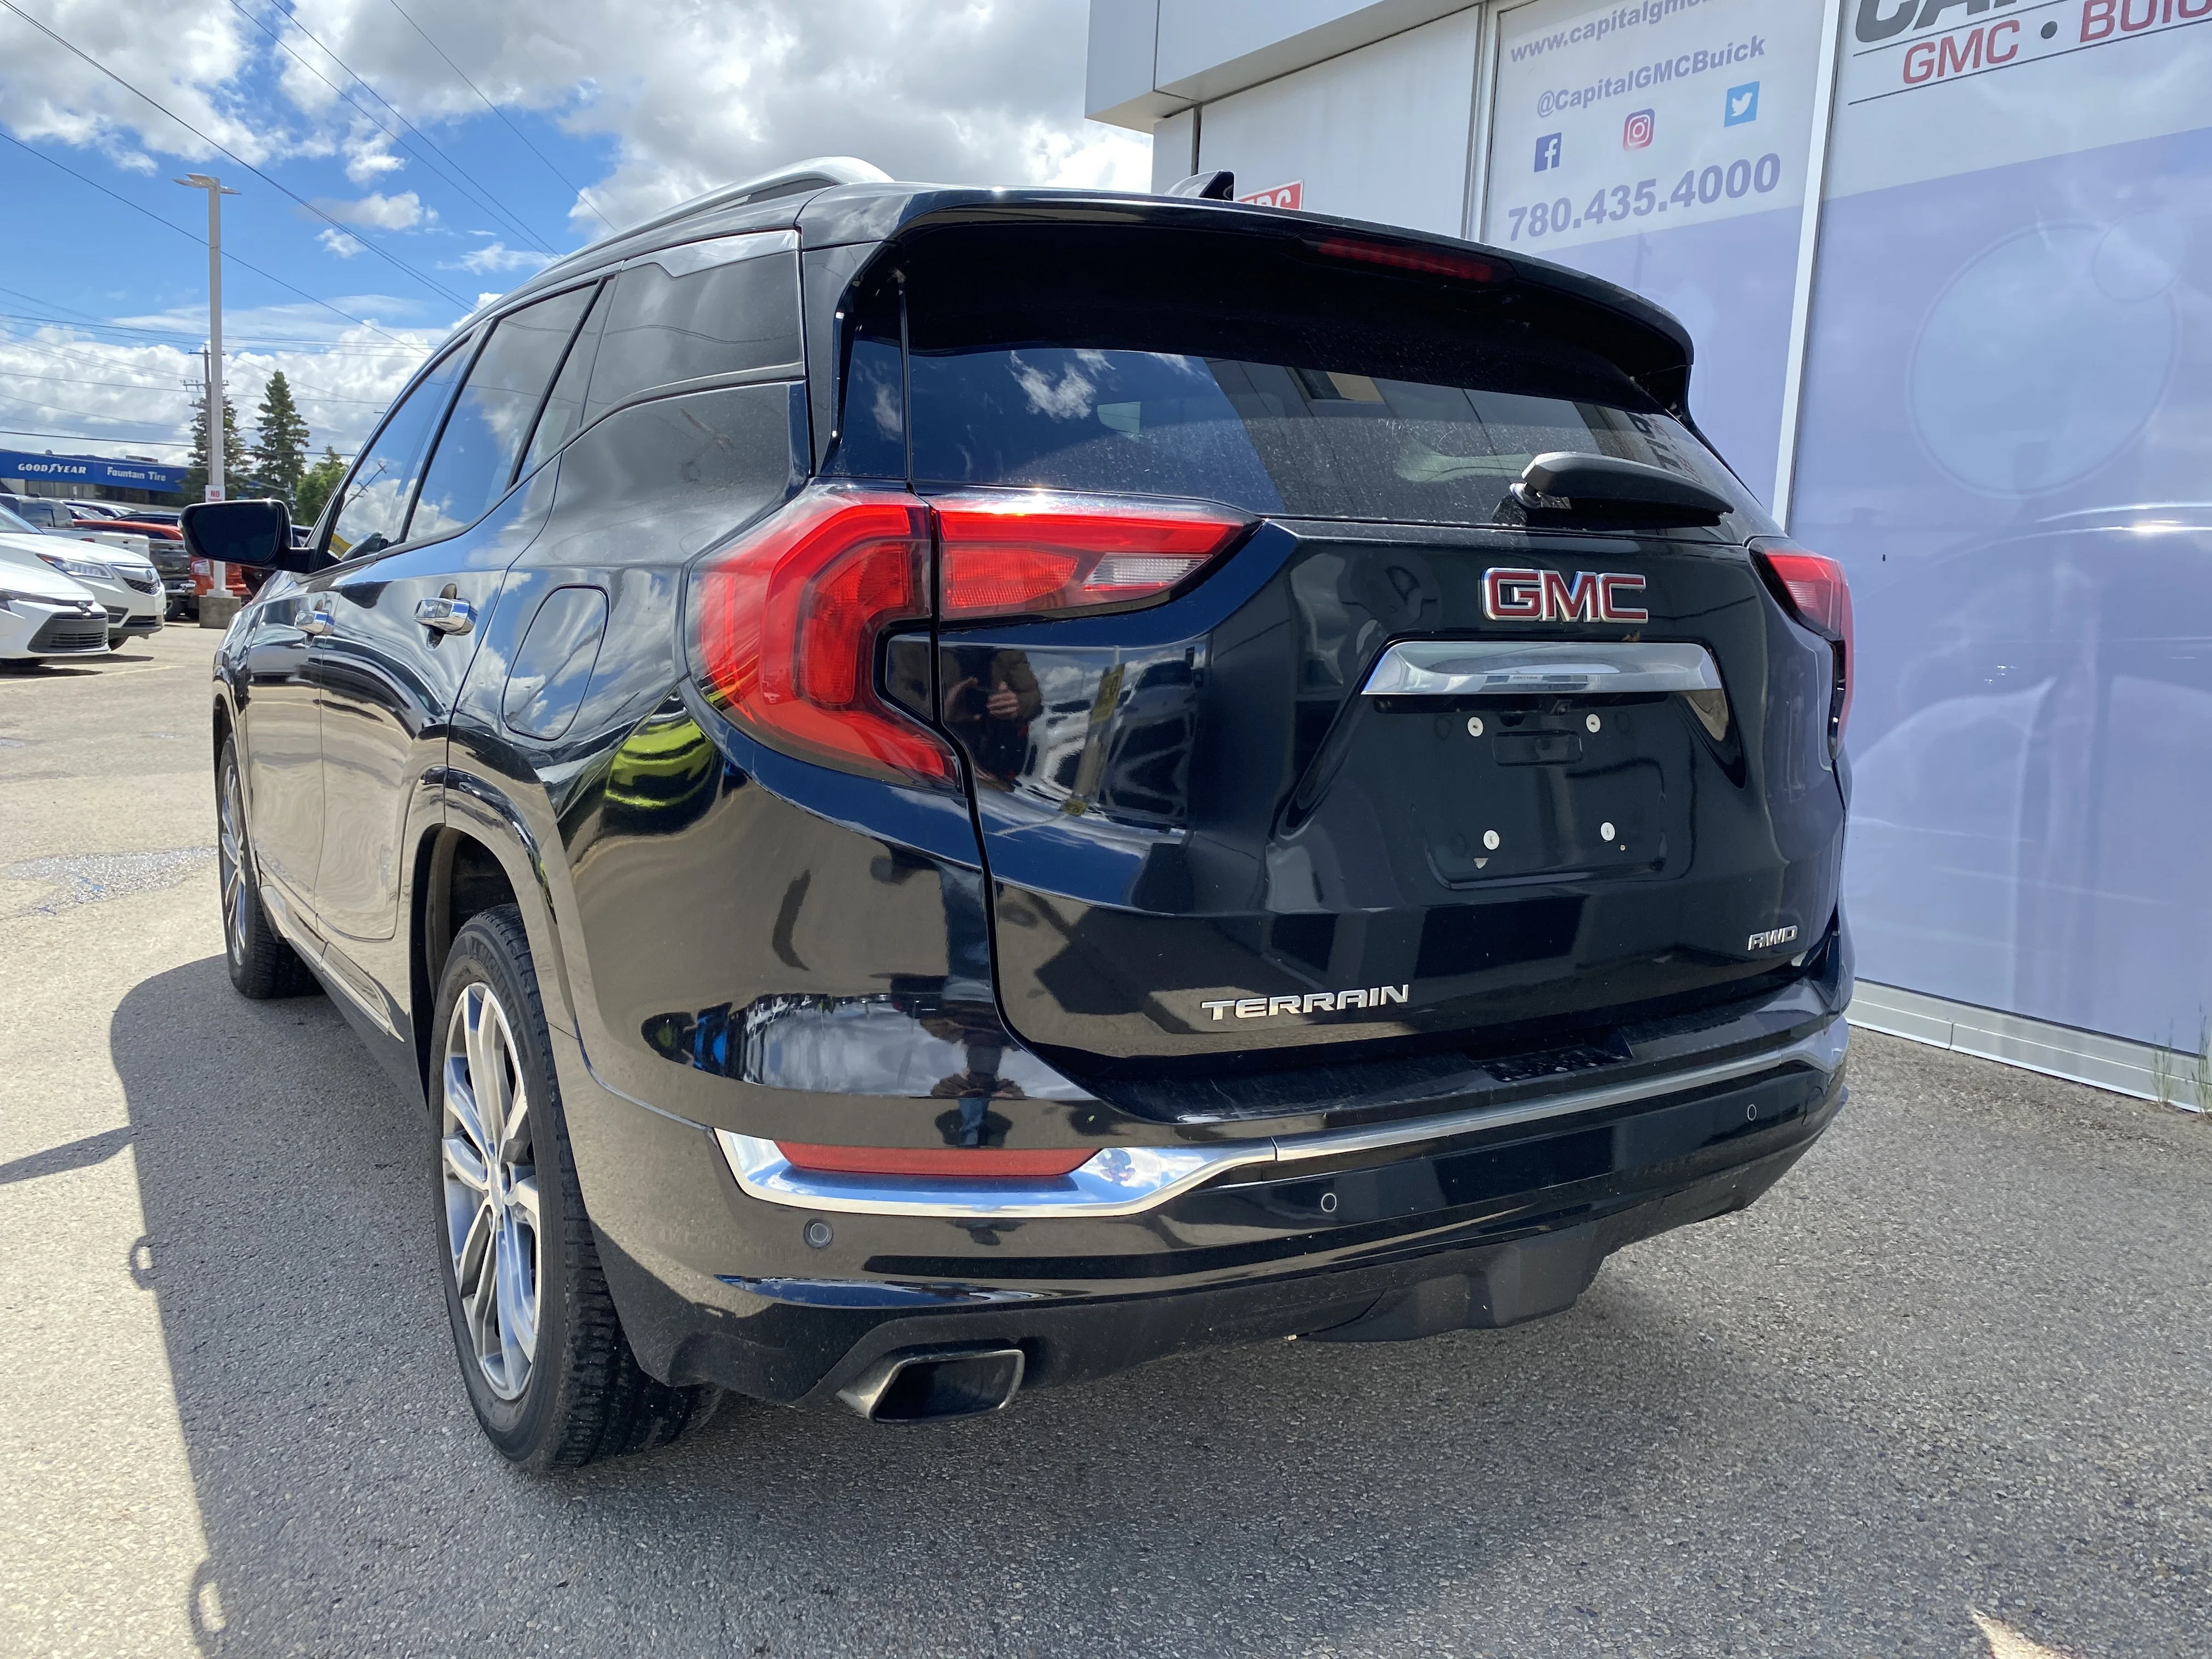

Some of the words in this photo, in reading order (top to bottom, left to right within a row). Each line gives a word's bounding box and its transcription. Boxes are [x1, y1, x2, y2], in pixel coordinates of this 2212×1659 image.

[1903, 19, 2020, 84] GMC
[1537, 35, 1767, 117] @CapitalGMCBuick
[1508, 153, 1781, 241] 780.435.4000
[18, 463, 87, 475] GOODYEAR
[106, 466, 145, 479] Fountain
[148, 471, 166, 482] Tire
[1481, 567, 1649, 624] GMC
[1747, 924, 1798, 951] AWD
[1201, 984, 1409, 1021] TERRAIN
